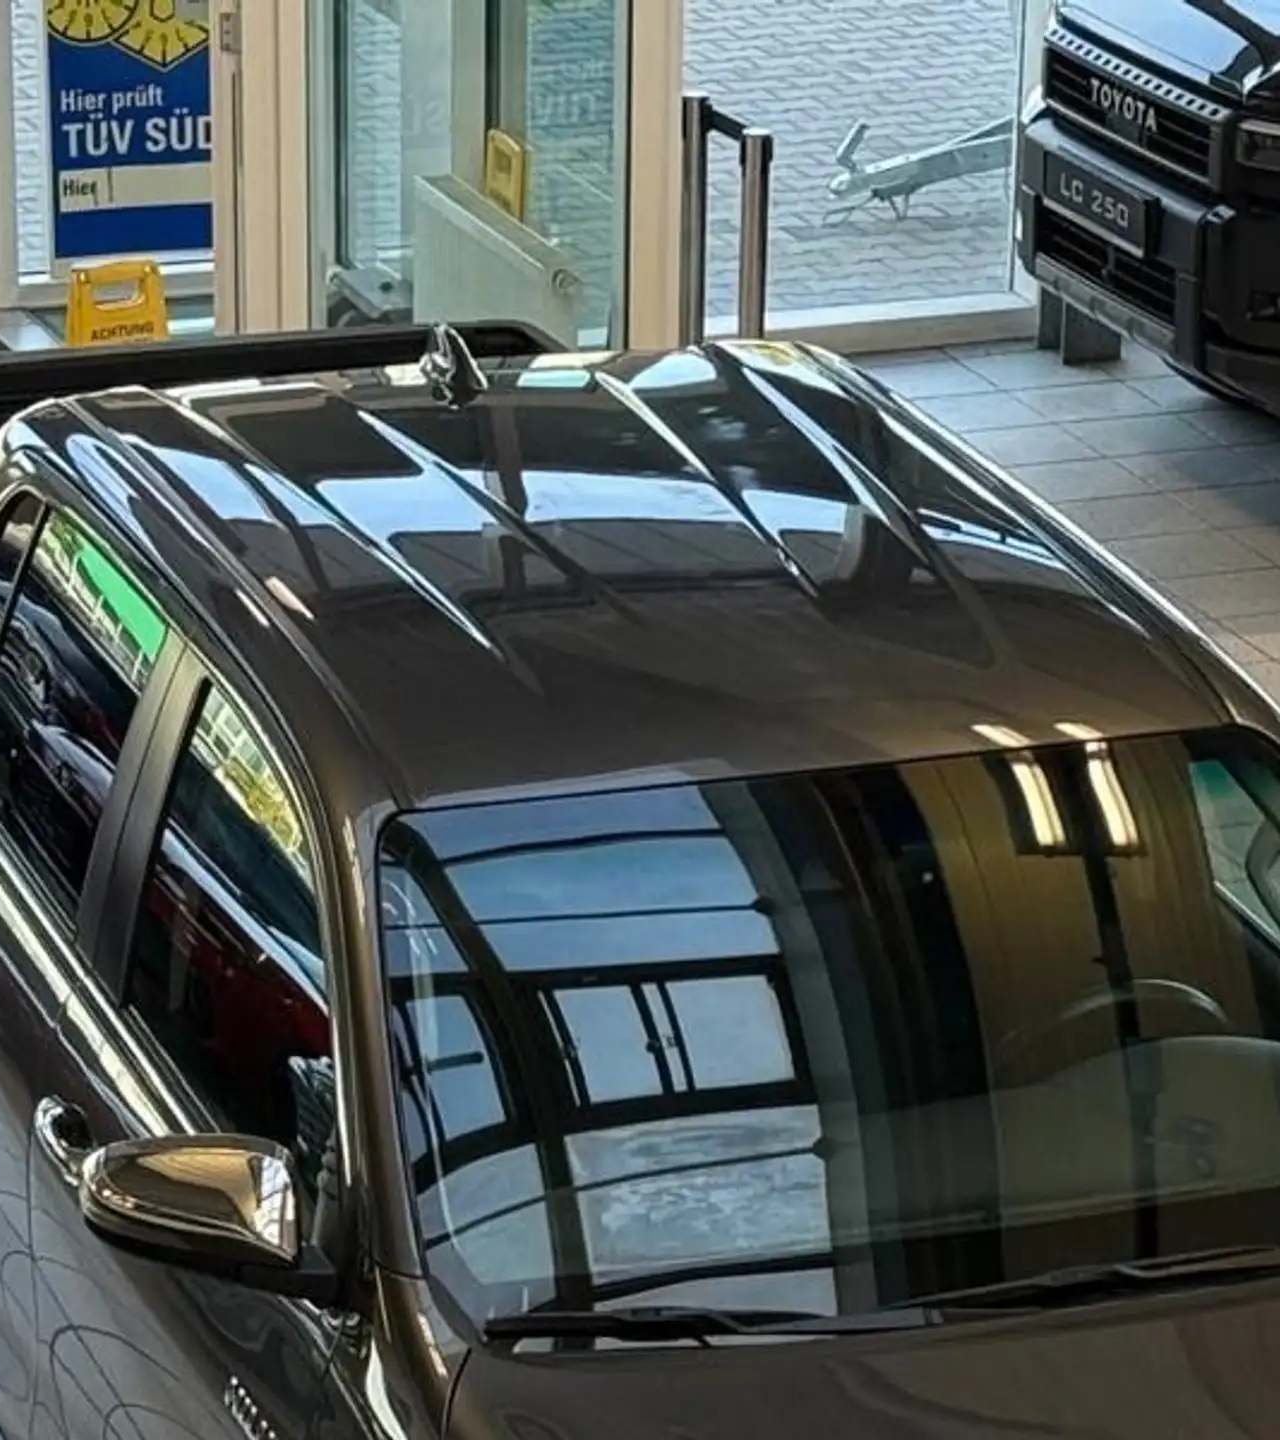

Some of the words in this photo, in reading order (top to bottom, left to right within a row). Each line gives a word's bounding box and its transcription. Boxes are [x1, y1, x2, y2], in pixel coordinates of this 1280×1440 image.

[60, 88, 107, 113] Hier
[111, 84, 163, 115] prüft
[1090, 77, 1158, 133] TOYOTA
[61, 112, 134, 158] TÜV
[144, 107, 213, 152] SÜD
[1060, 172, 1084, 203] LC
[1091, 189, 1129, 230] 250
